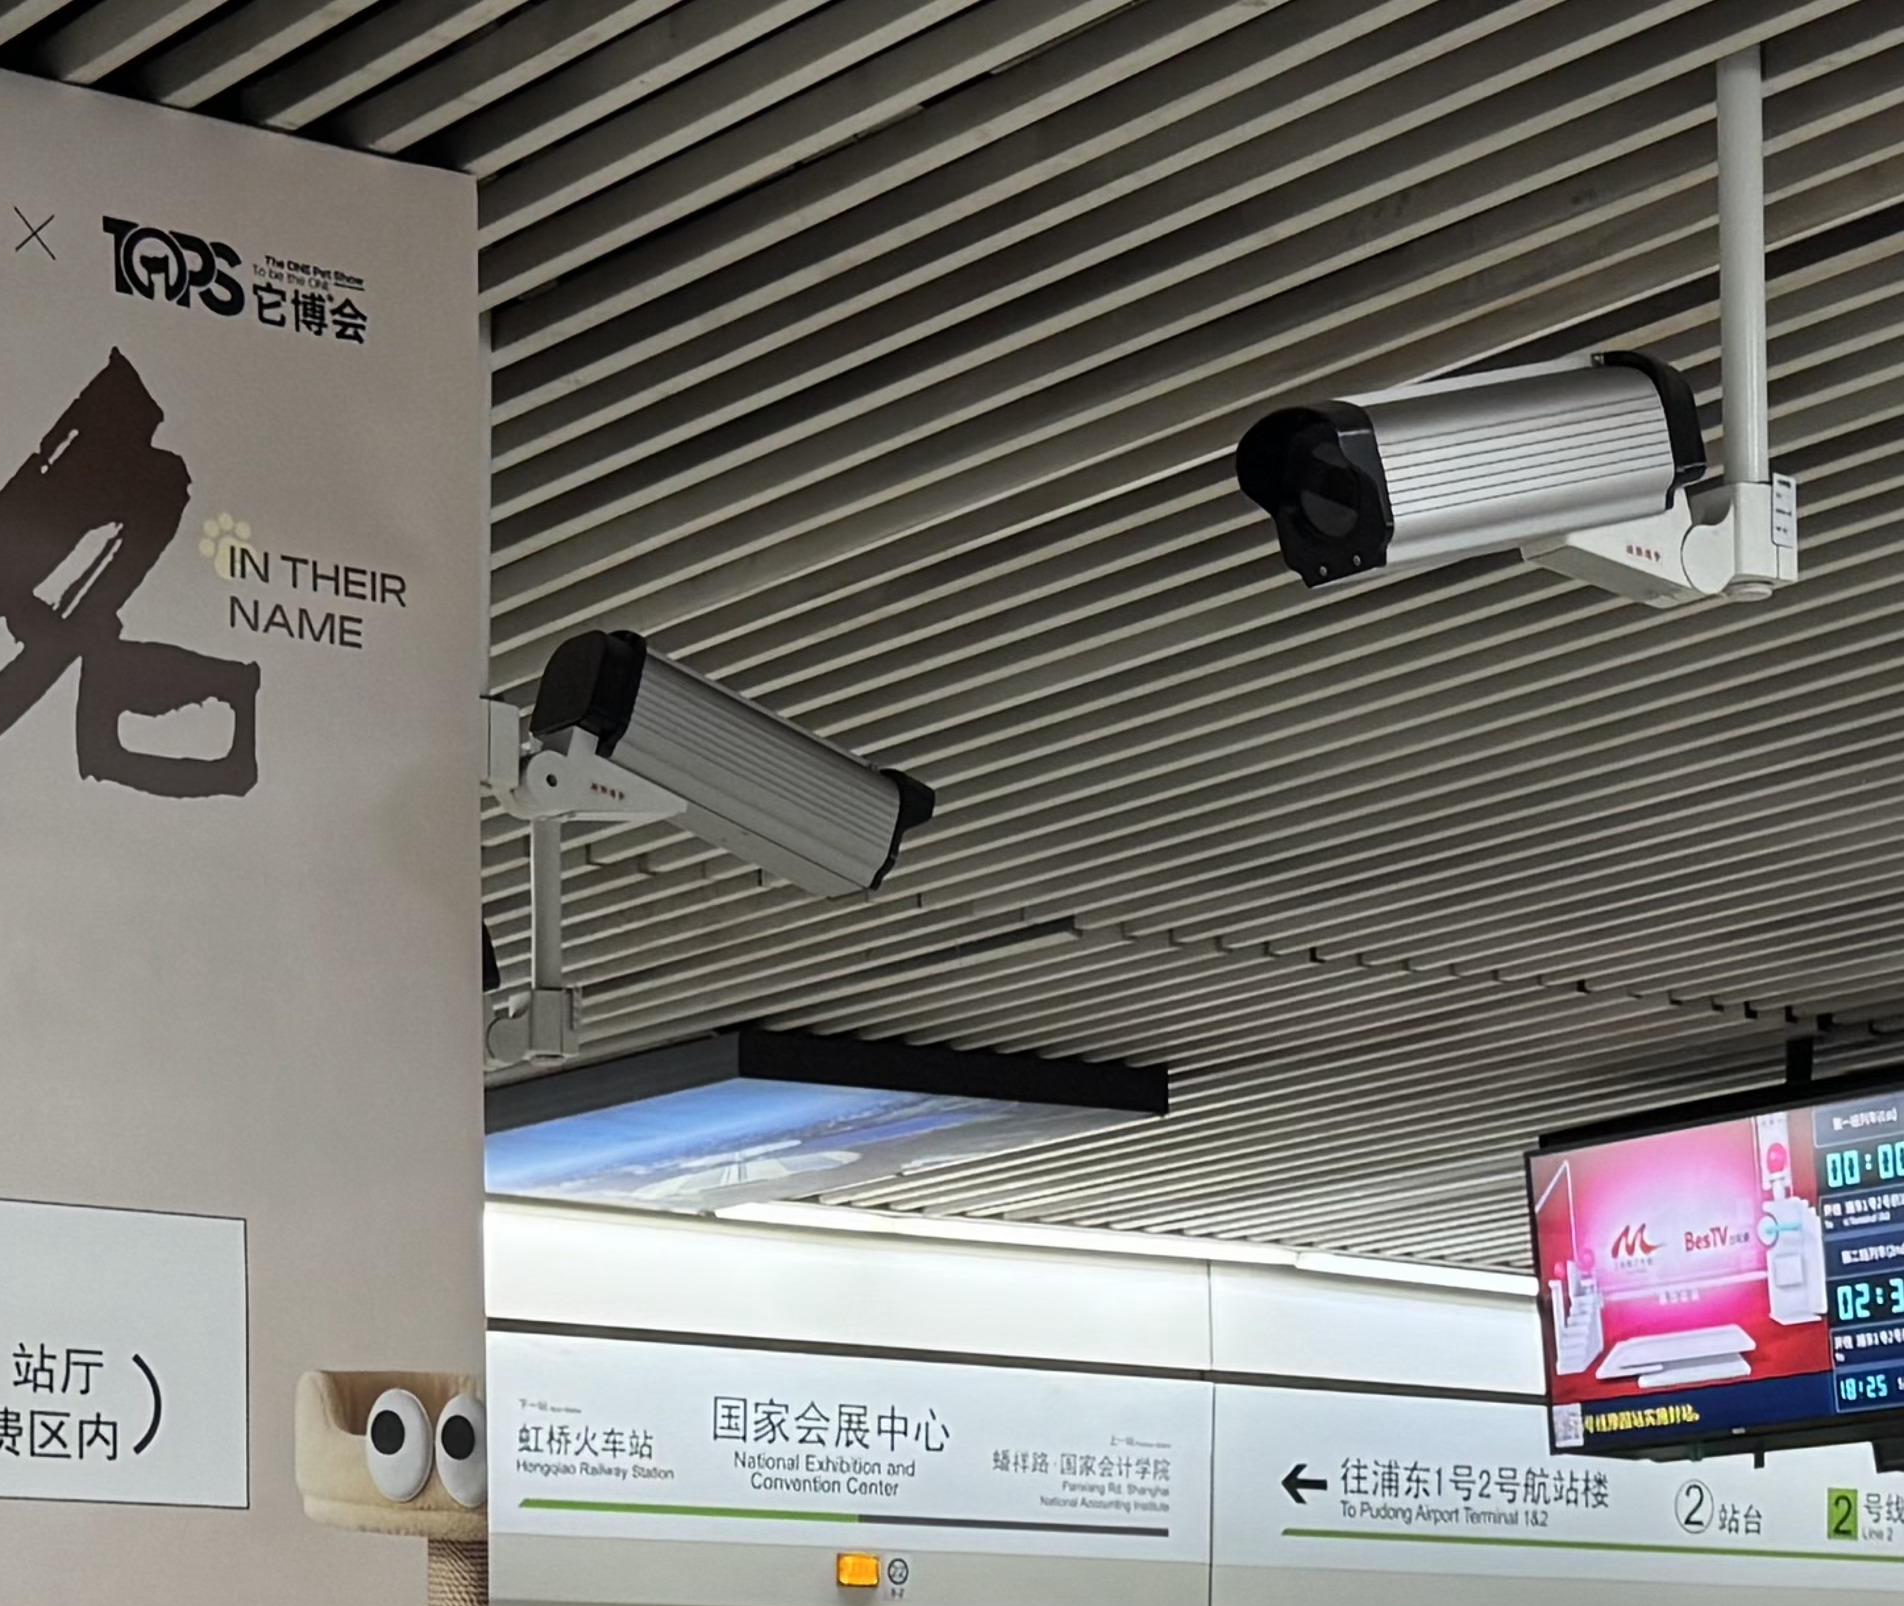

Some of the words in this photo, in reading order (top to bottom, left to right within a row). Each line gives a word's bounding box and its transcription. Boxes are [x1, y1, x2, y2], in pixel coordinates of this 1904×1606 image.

[252, 281, 368, 345] 它博会
[228, 545, 270, 584] IN
[280, 553, 407, 608] THEIR
[228, 594, 364, 649] NAME
[12, 1344, 105, 1397] 站厅
[1840, 1374, 1888, 1402] 18:25
[517, 1424, 653, 1460] 虹桥火车站
[713, 1396, 950, 1453] 国家会展中心
[516, 1459, 577, 1478] Hongqiao
[579, 1461, 628, 1481] Railway
[631, 1464, 675, 1480] Station
[734, 1451, 799, 1472] National
[805, 1454, 882, 1476] Exhibition
[887, 1459, 916, 1477] and
[1340, 1456, 1610, 1509] 往浦东1号2号航站楼
[750, 1472, 841, 1495] Convention
[846, 1477, 900, 1498] Center
[1340, 1500, 1357, 1519] To
[1360, 1501, 1413, 1525] Pudong
[1415, 1504, 1460, 1526] Airport
[1463, 1506, 1520, 1527] Terminal
[1718, 1503, 1763, 1535] 站台
[1832, 1494, 1853, 1535] 2
